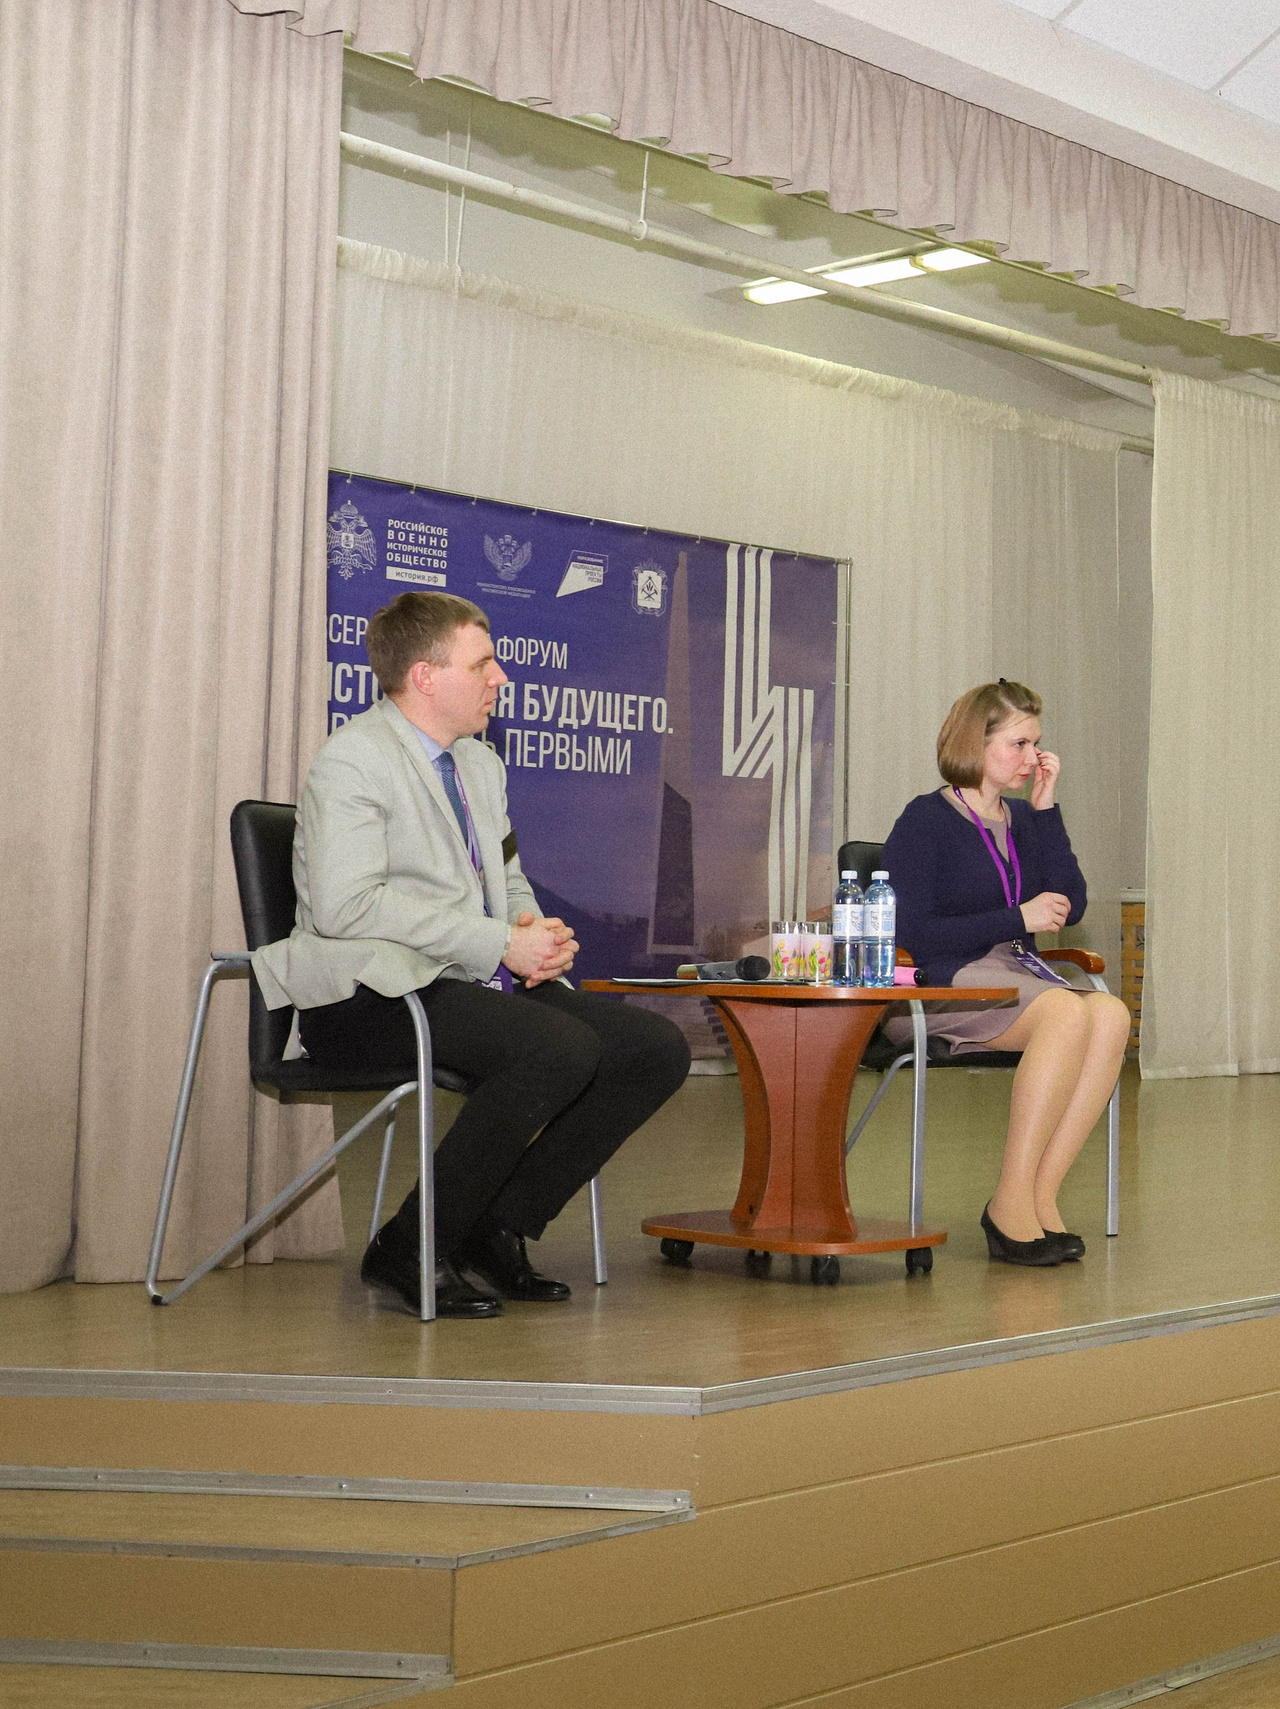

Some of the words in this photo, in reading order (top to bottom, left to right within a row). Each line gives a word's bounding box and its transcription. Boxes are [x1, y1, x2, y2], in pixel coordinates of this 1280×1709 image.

[388, 519, 448, 536] РОССИЙСКОЕ
[387, 529, 448, 548] ВОЕННО
[387, 542, 447, 557] ИСТОРИЧЕСКОЕ
[386, 552, 447, 569] ОБЩЕСТВО
[396, 571, 438, 584] история.рф
[496, 635, 568, 670] ФОРУМ
[523, 683, 673, 734] БУДУЩЕГО.
[505, 728, 632, 775] ПЕРВЫМИ
